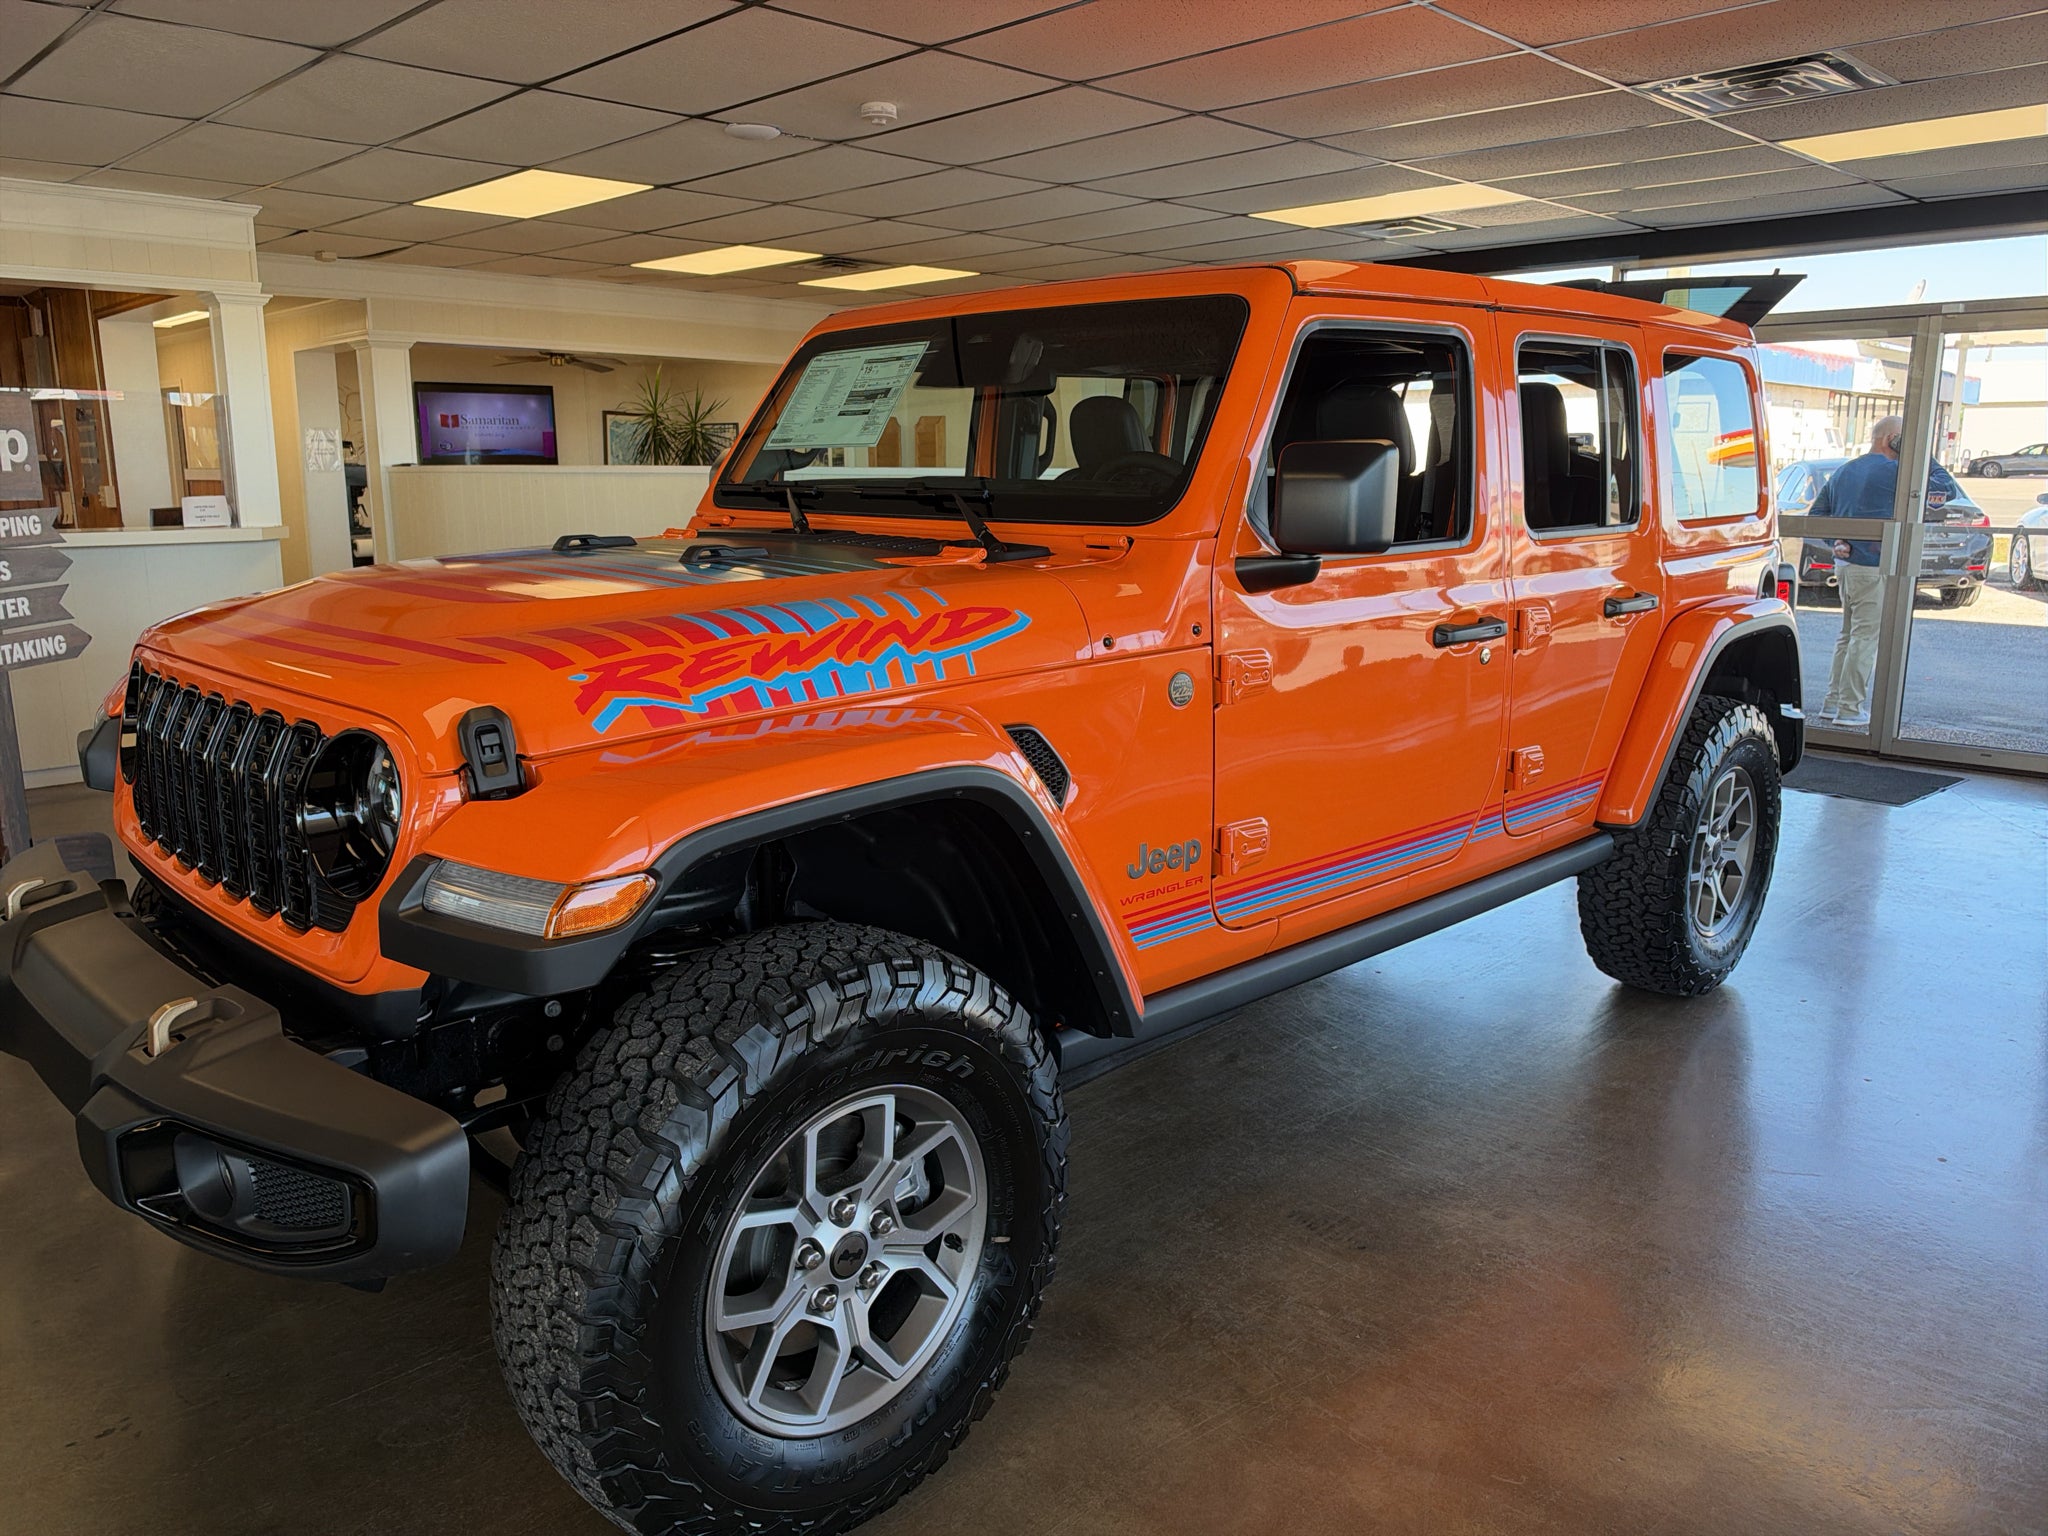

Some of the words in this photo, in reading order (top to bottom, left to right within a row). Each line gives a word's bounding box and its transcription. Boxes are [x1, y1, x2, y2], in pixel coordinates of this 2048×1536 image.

[460, 413, 520, 426] Samaritan
[0, 515, 42, 538] PING
[0, 634, 67, 666] TAKING
[573, 606, 1011, 715] REWIND
[1127, 838, 1202, 880] Jeep
[1119, 875, 1204, 907] WRANGLER
